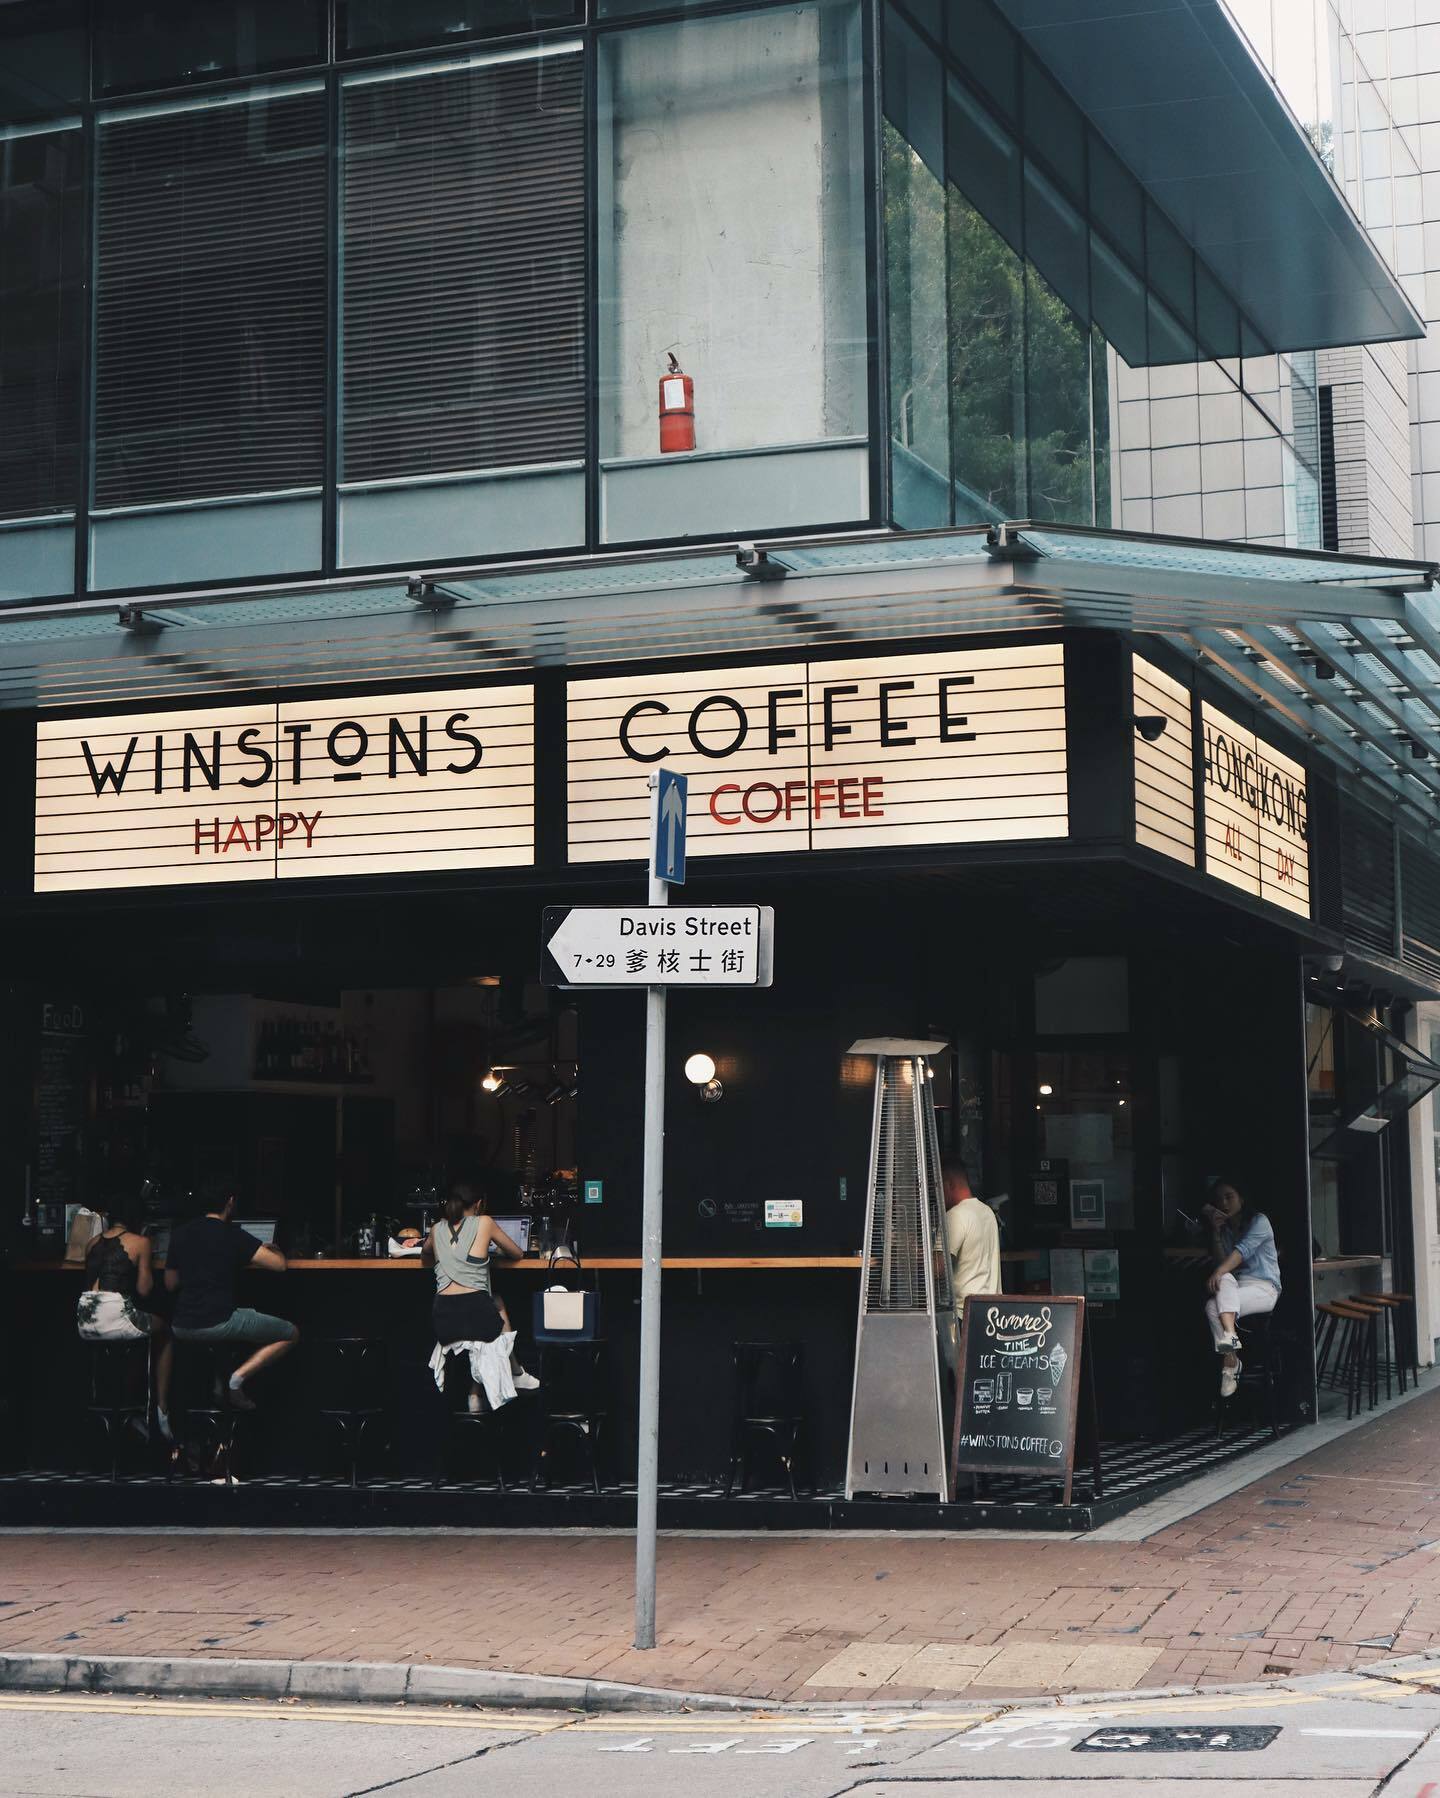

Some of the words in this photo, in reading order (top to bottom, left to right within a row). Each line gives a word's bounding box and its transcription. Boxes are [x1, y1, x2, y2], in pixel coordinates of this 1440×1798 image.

[618, 676, 977, 763] COFFEE
[81, 712, 483, 798] WINSTONS
[709, 776, 885, 826] COFFEE
[194, 810, 323, 855] HAPPY
[1224, 820, 1243, 862] ALL
[1277, 847, 1295, 887] DAY
[619, 917, 677, 936] Davis
[684, 916, 752, 936] Street
[625, 948, 745, 974] 爹核士街
[985, 1306, 1053, 1341] Summer
[979, 1354, 996, 1369] ICE
[1004, 1339, 1030, 1351] TIME
[597, 1737, 882, 1755] LEFT
